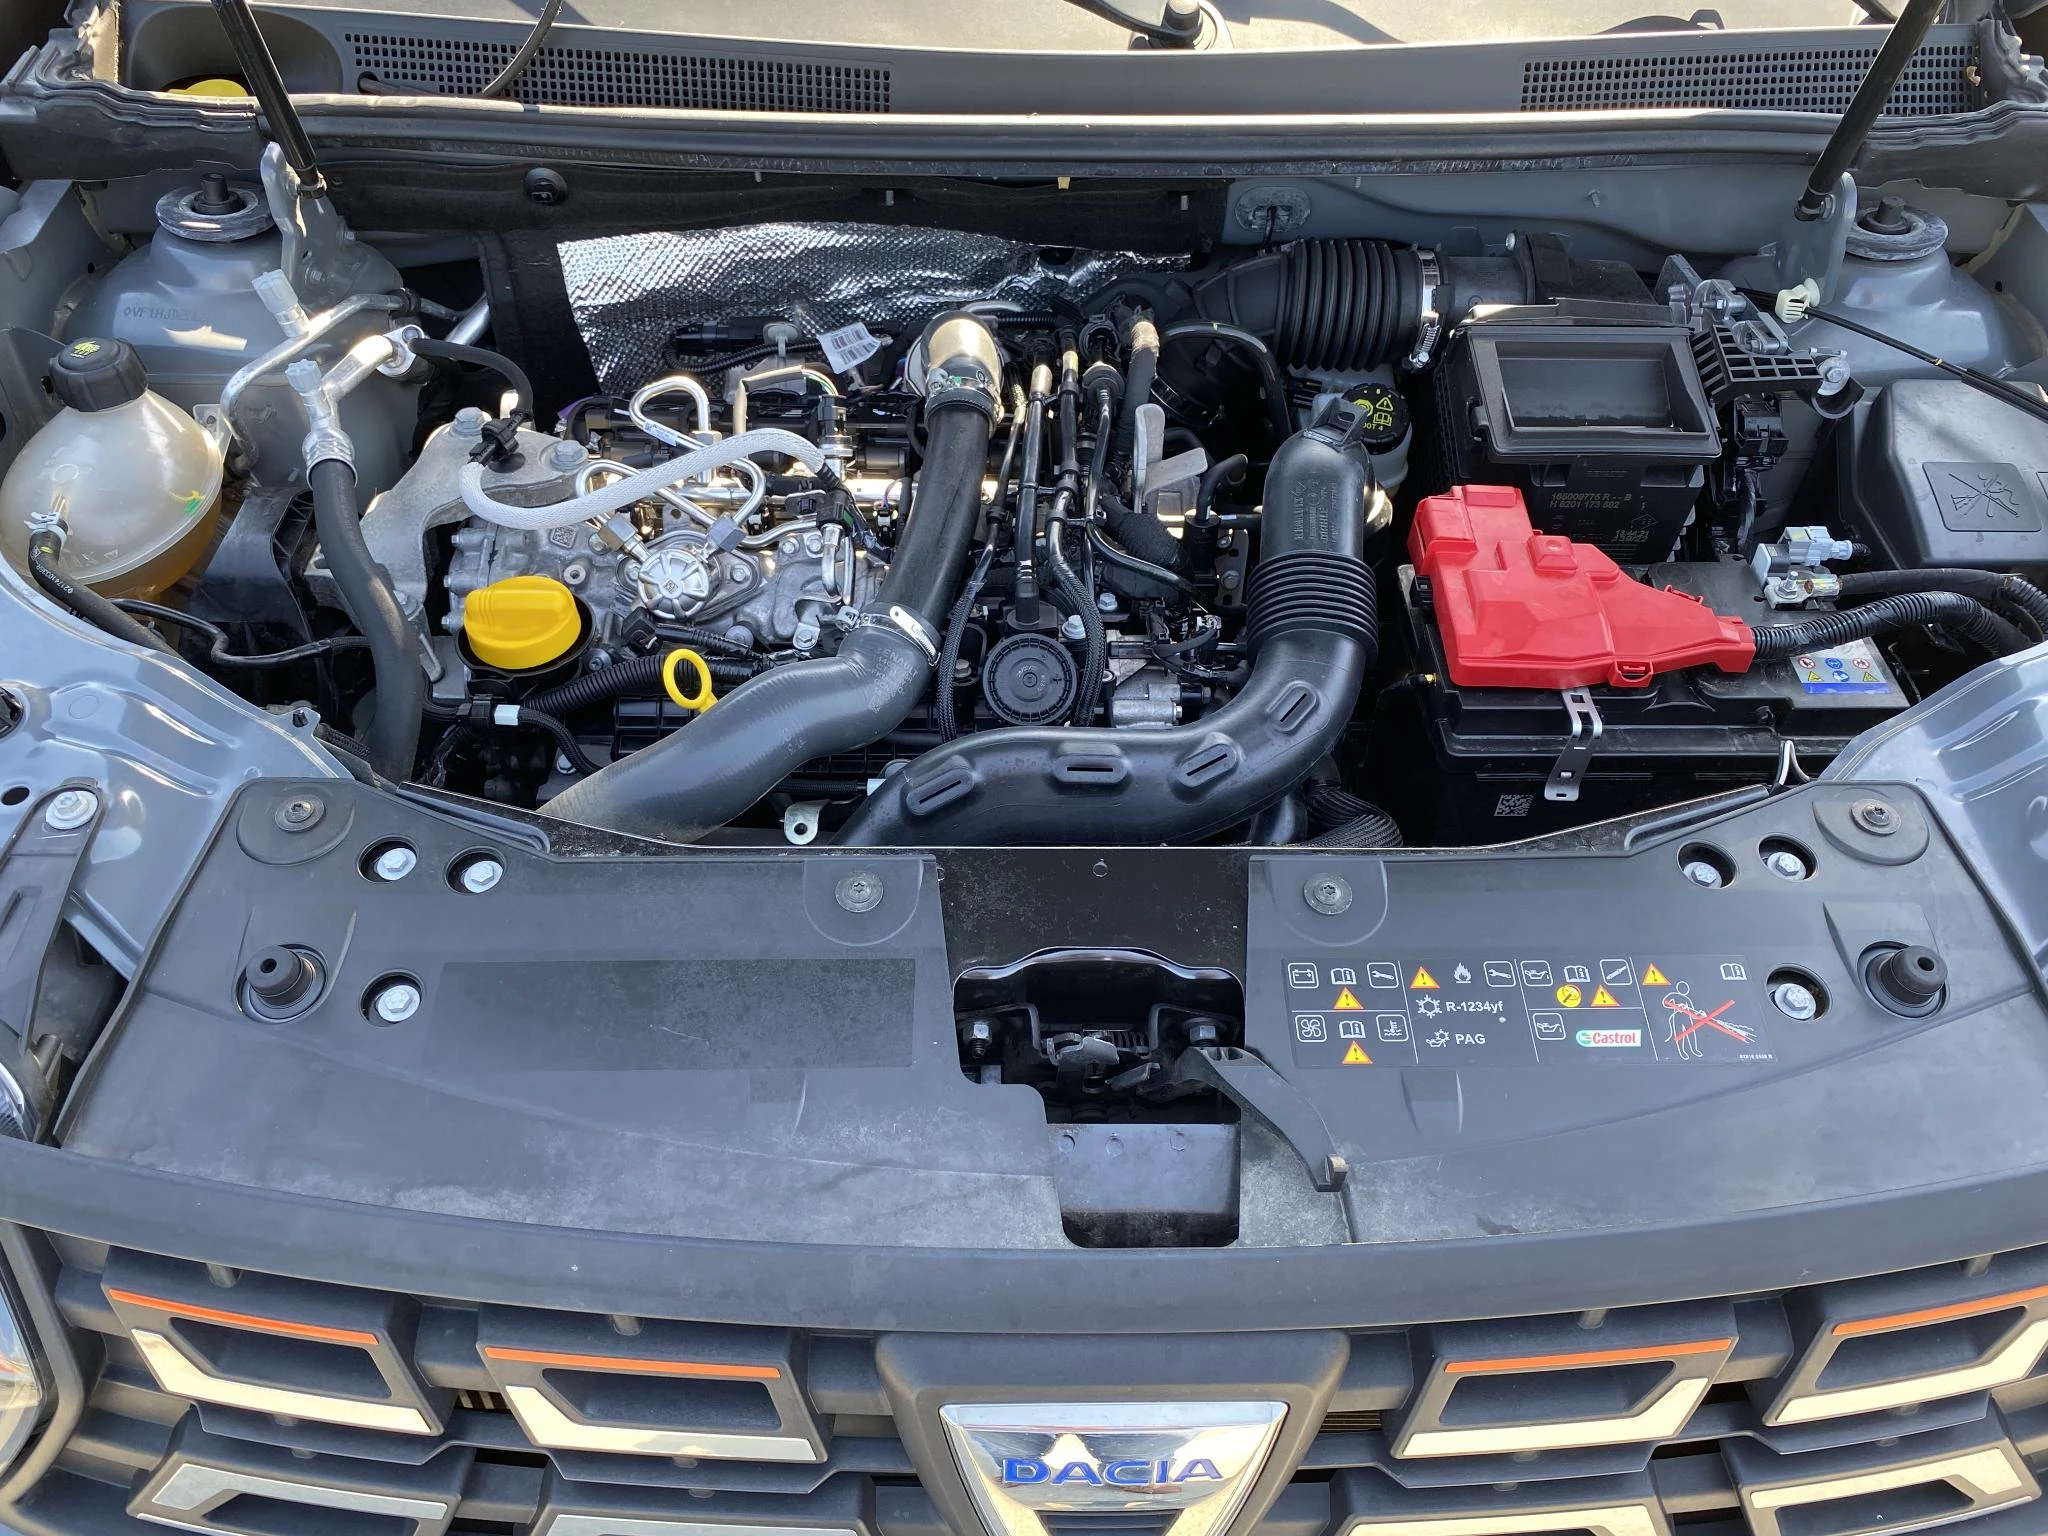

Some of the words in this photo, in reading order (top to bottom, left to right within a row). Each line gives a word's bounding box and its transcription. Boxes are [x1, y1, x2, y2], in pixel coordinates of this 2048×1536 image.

[1446, 1001, 1503, 1013] R-1234yf
[1455, 1033, 1486, 1045] PAG
[1592, 1032, 1638, 1044] Castrol
[1002, 1458, 1223, 1486] DACIA
